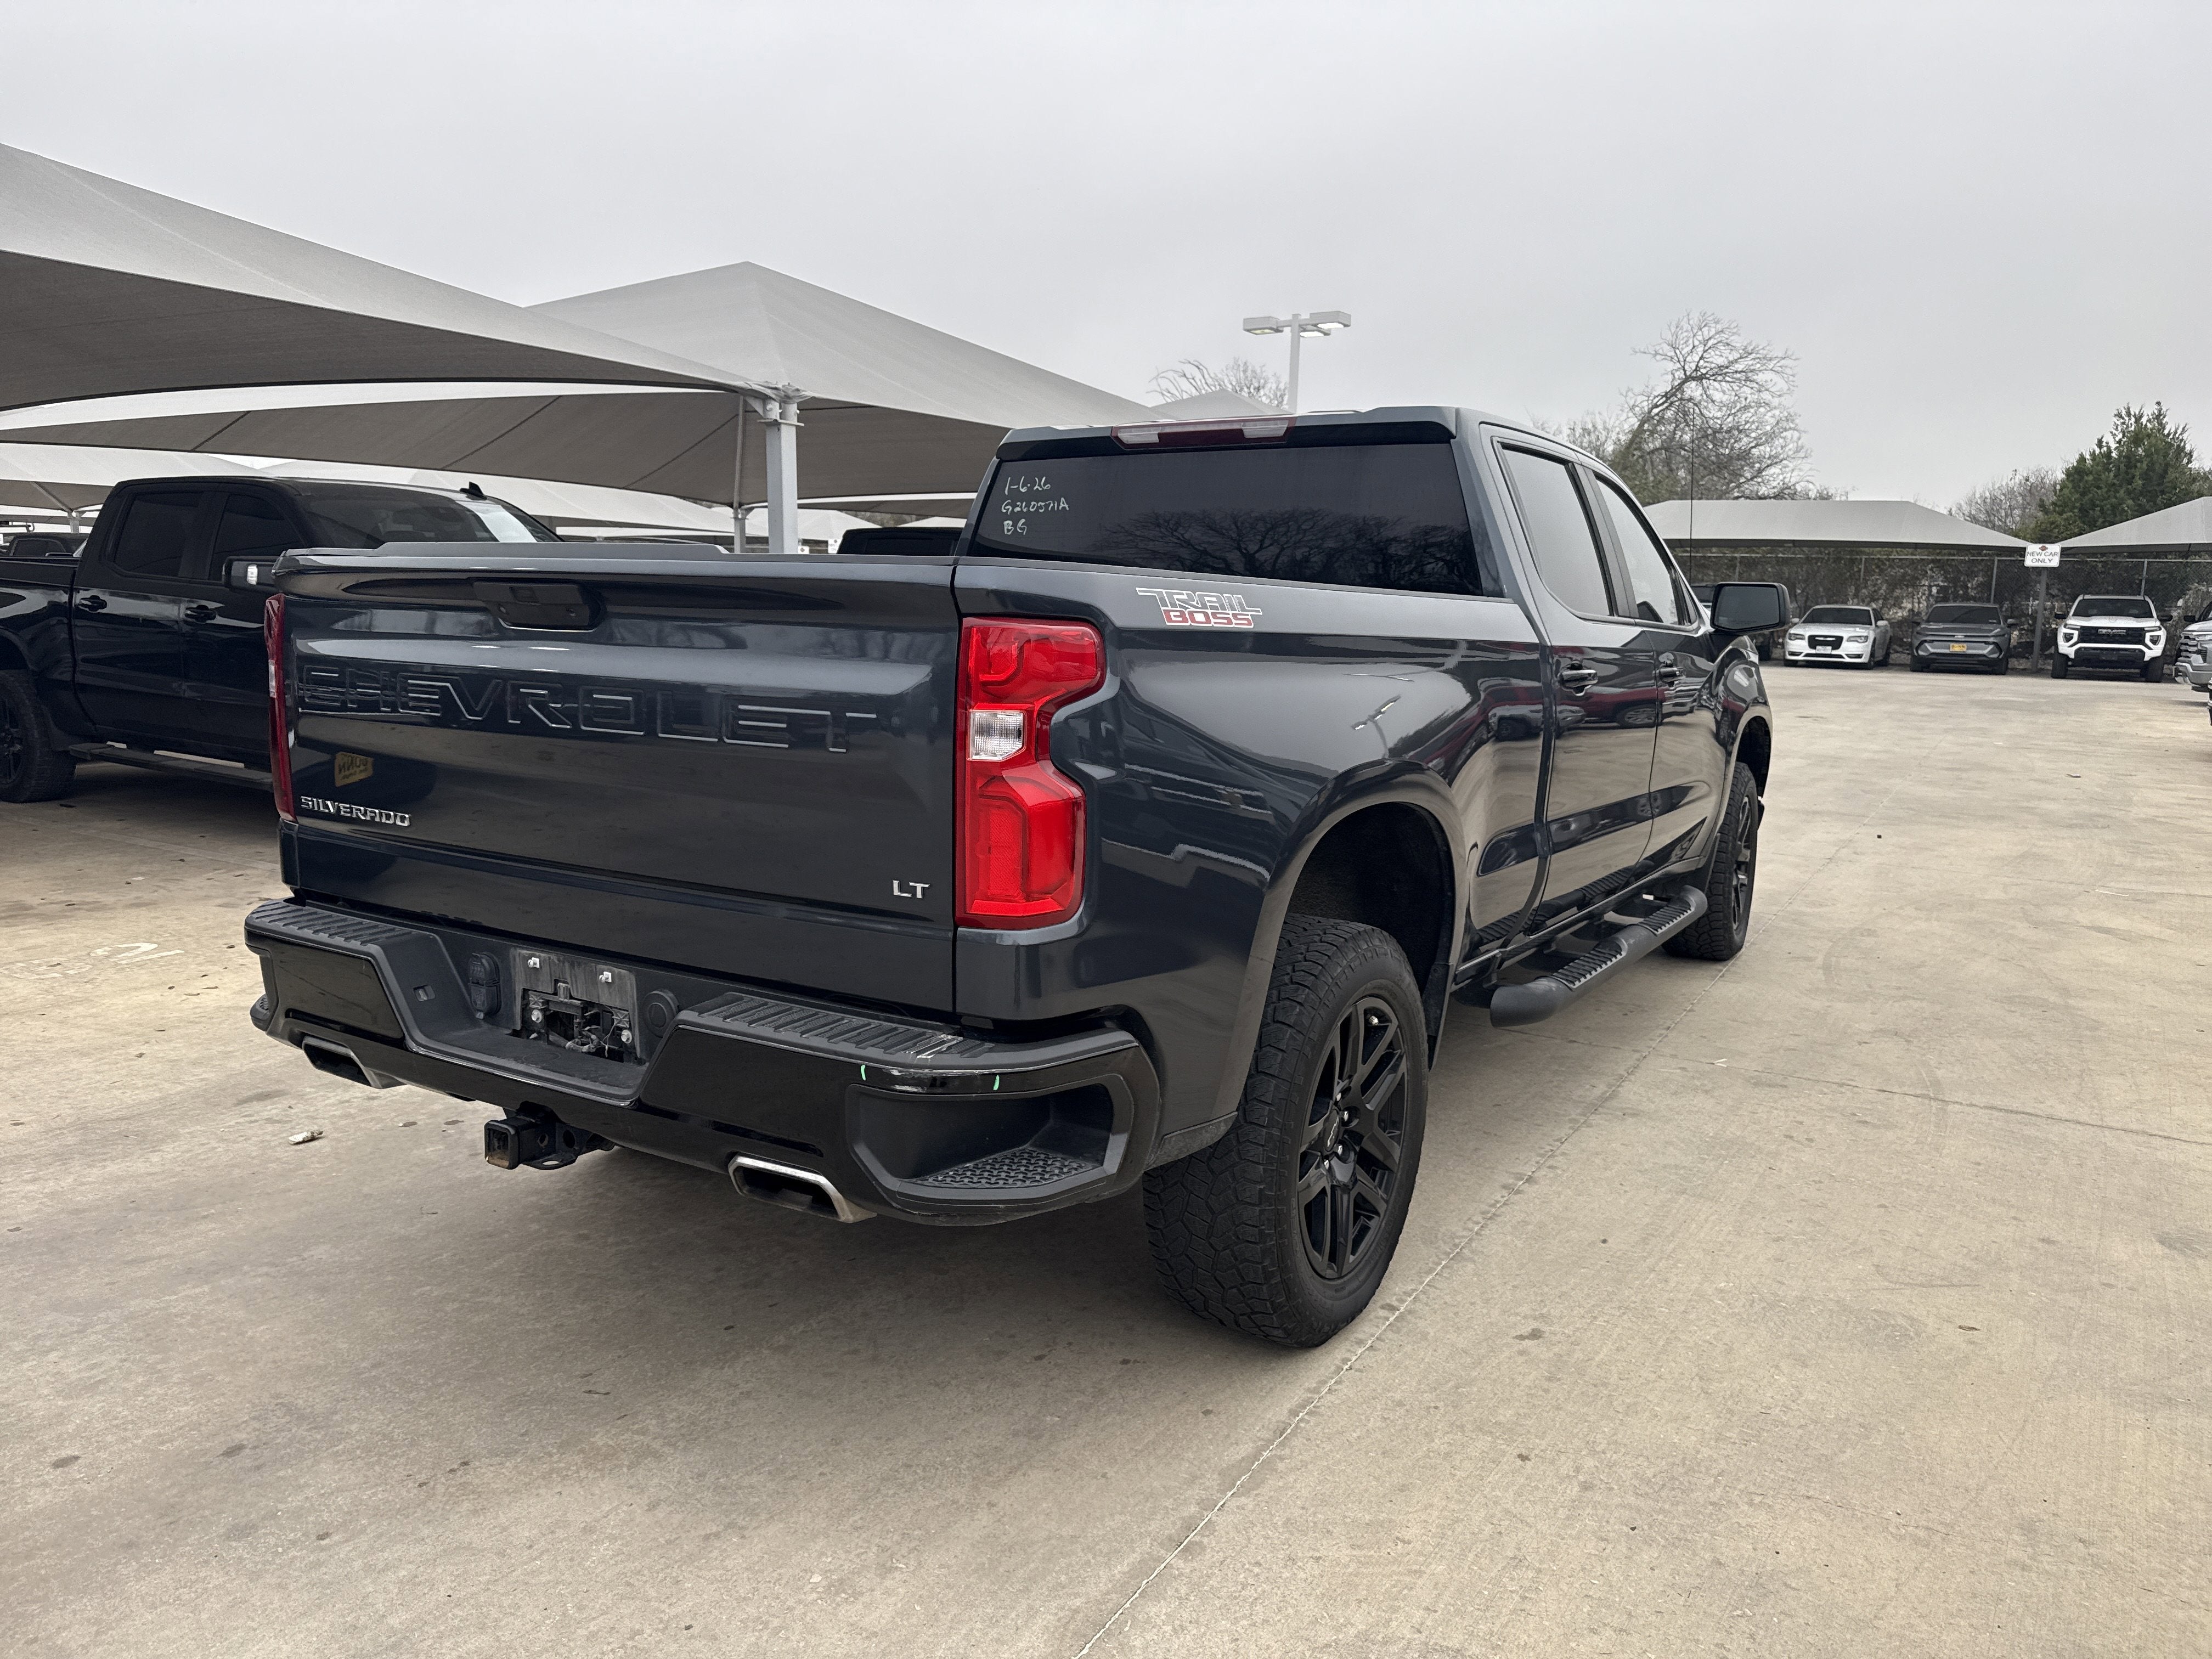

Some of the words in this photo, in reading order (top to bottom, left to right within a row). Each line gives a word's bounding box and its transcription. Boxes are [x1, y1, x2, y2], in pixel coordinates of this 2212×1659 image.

[1001, 497, 1069, 515] G260571A
[1135, 587, 1262, 615] TRAIL
[1163, 607, 1254, 628] BOSS
[303, 665, 878, 753] CHEVROLET
[300, 796, 411, 827] SILVERADO
[892, 880, 931, 899] LT
